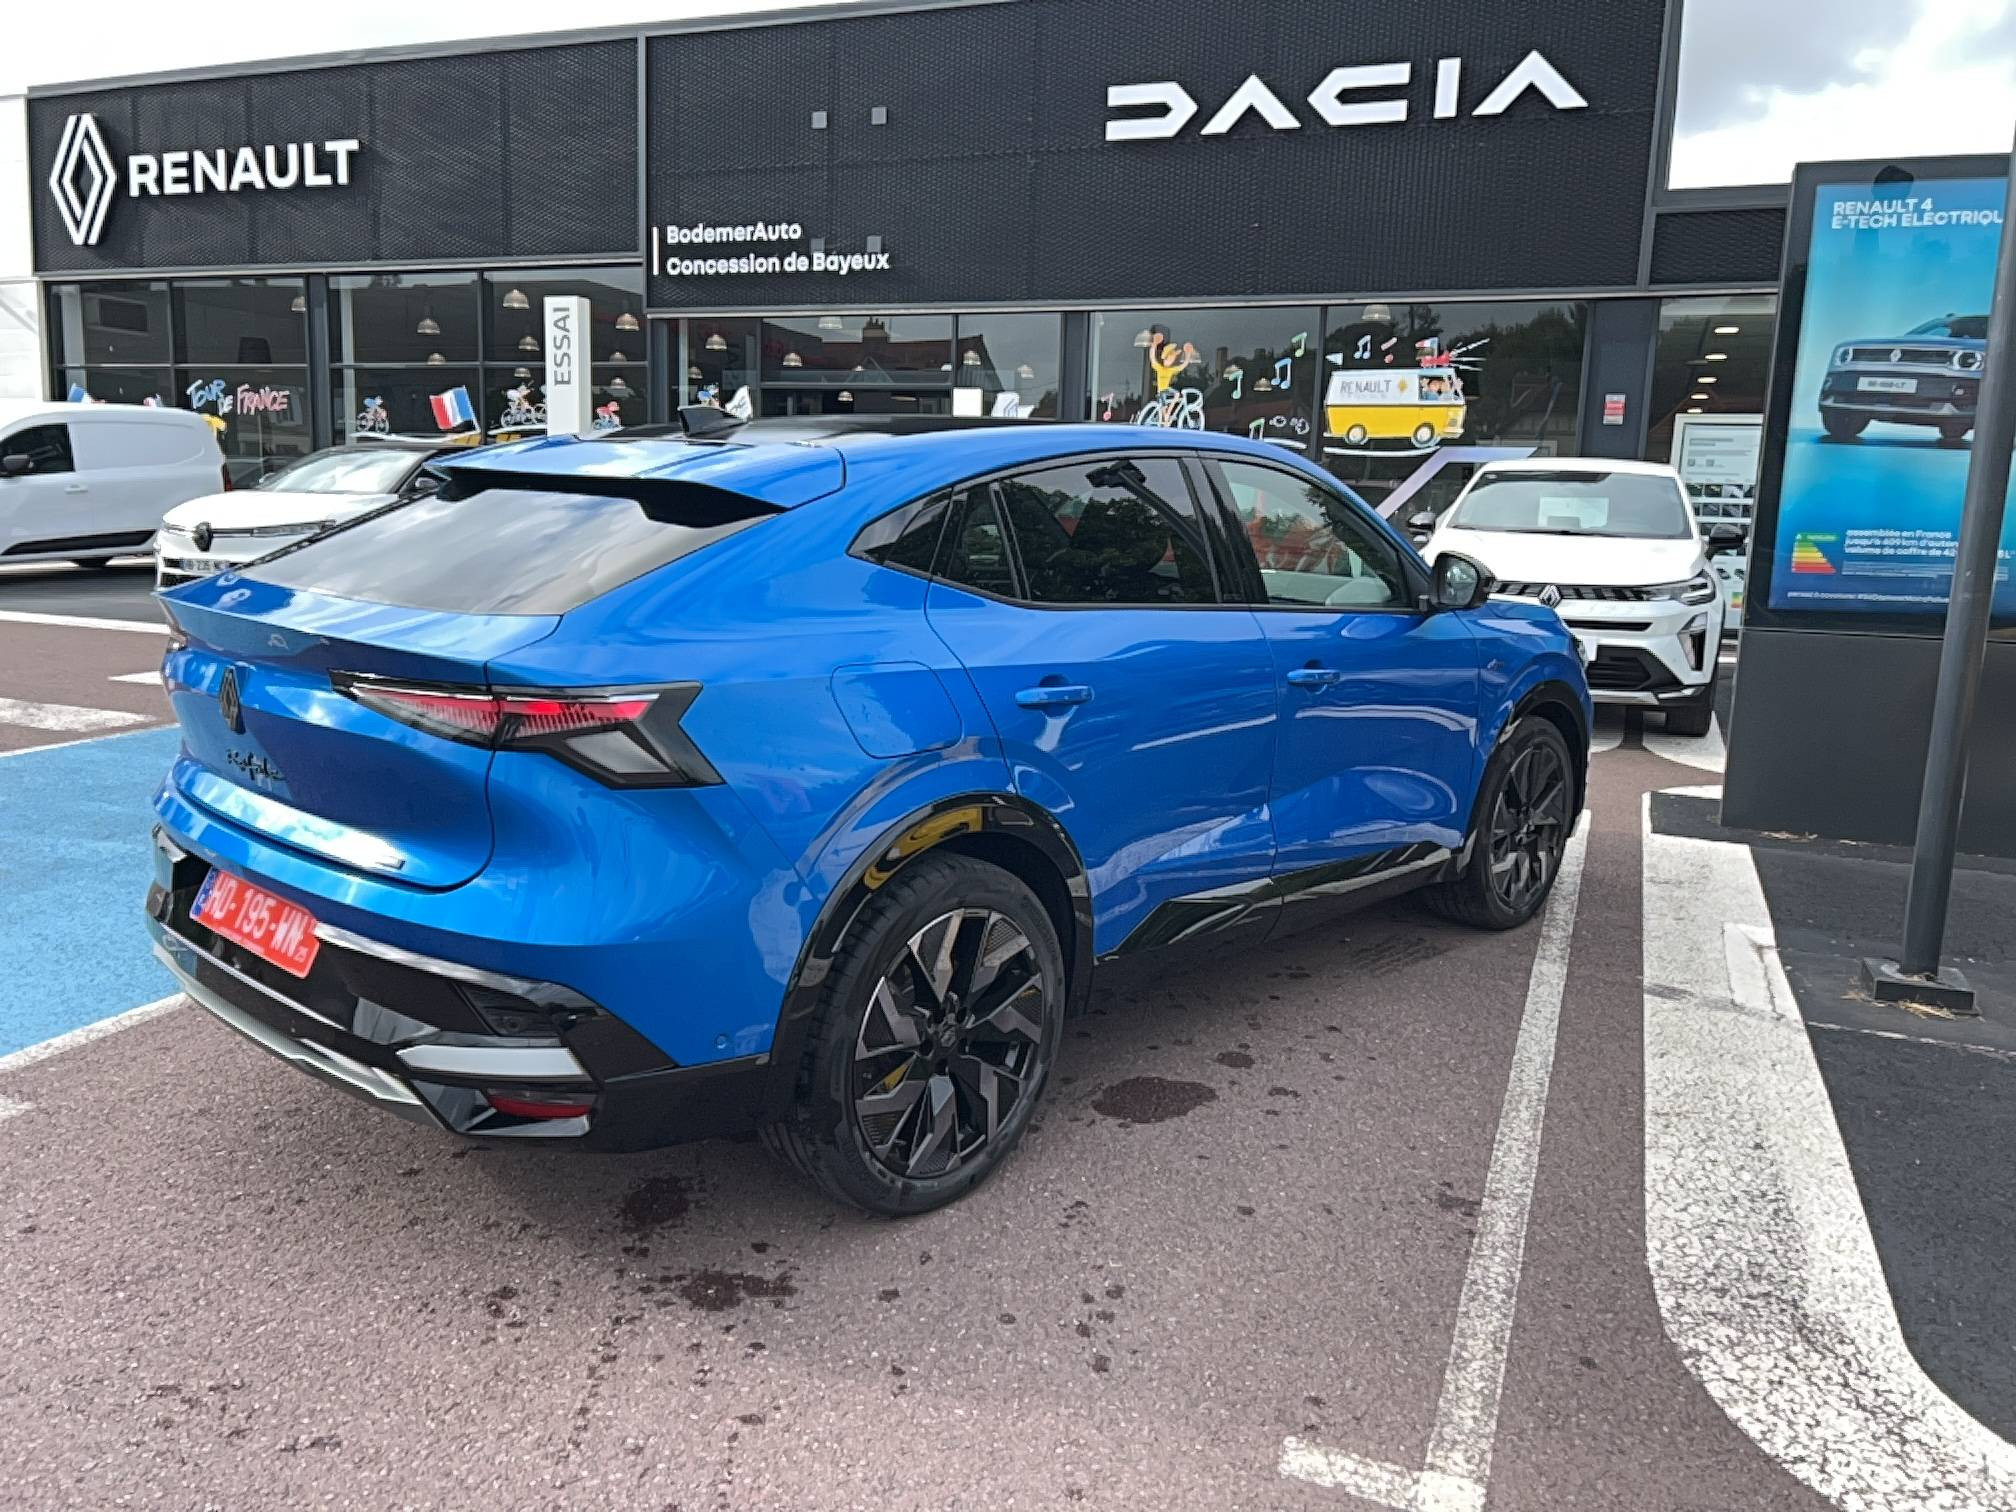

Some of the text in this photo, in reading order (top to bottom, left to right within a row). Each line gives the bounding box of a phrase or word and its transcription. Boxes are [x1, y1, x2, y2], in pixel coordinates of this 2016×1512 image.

[1105, 49, 1589, 141] DACIA
[128, 138, 360, 198] RENAULT
[1833, 198, 1933, 215] RENAULT 4
[666, 221, 802, 244] BodemerAuto
[1831, 213, 1898, 229] E-TECH
[666, 251, 890, 276] Concession de Bayeux
[553, 306, 571, 386] ESSAI
[1340, 379, 1392, 394] RENAULT
[237, 383, 291, 416] FRANCE
